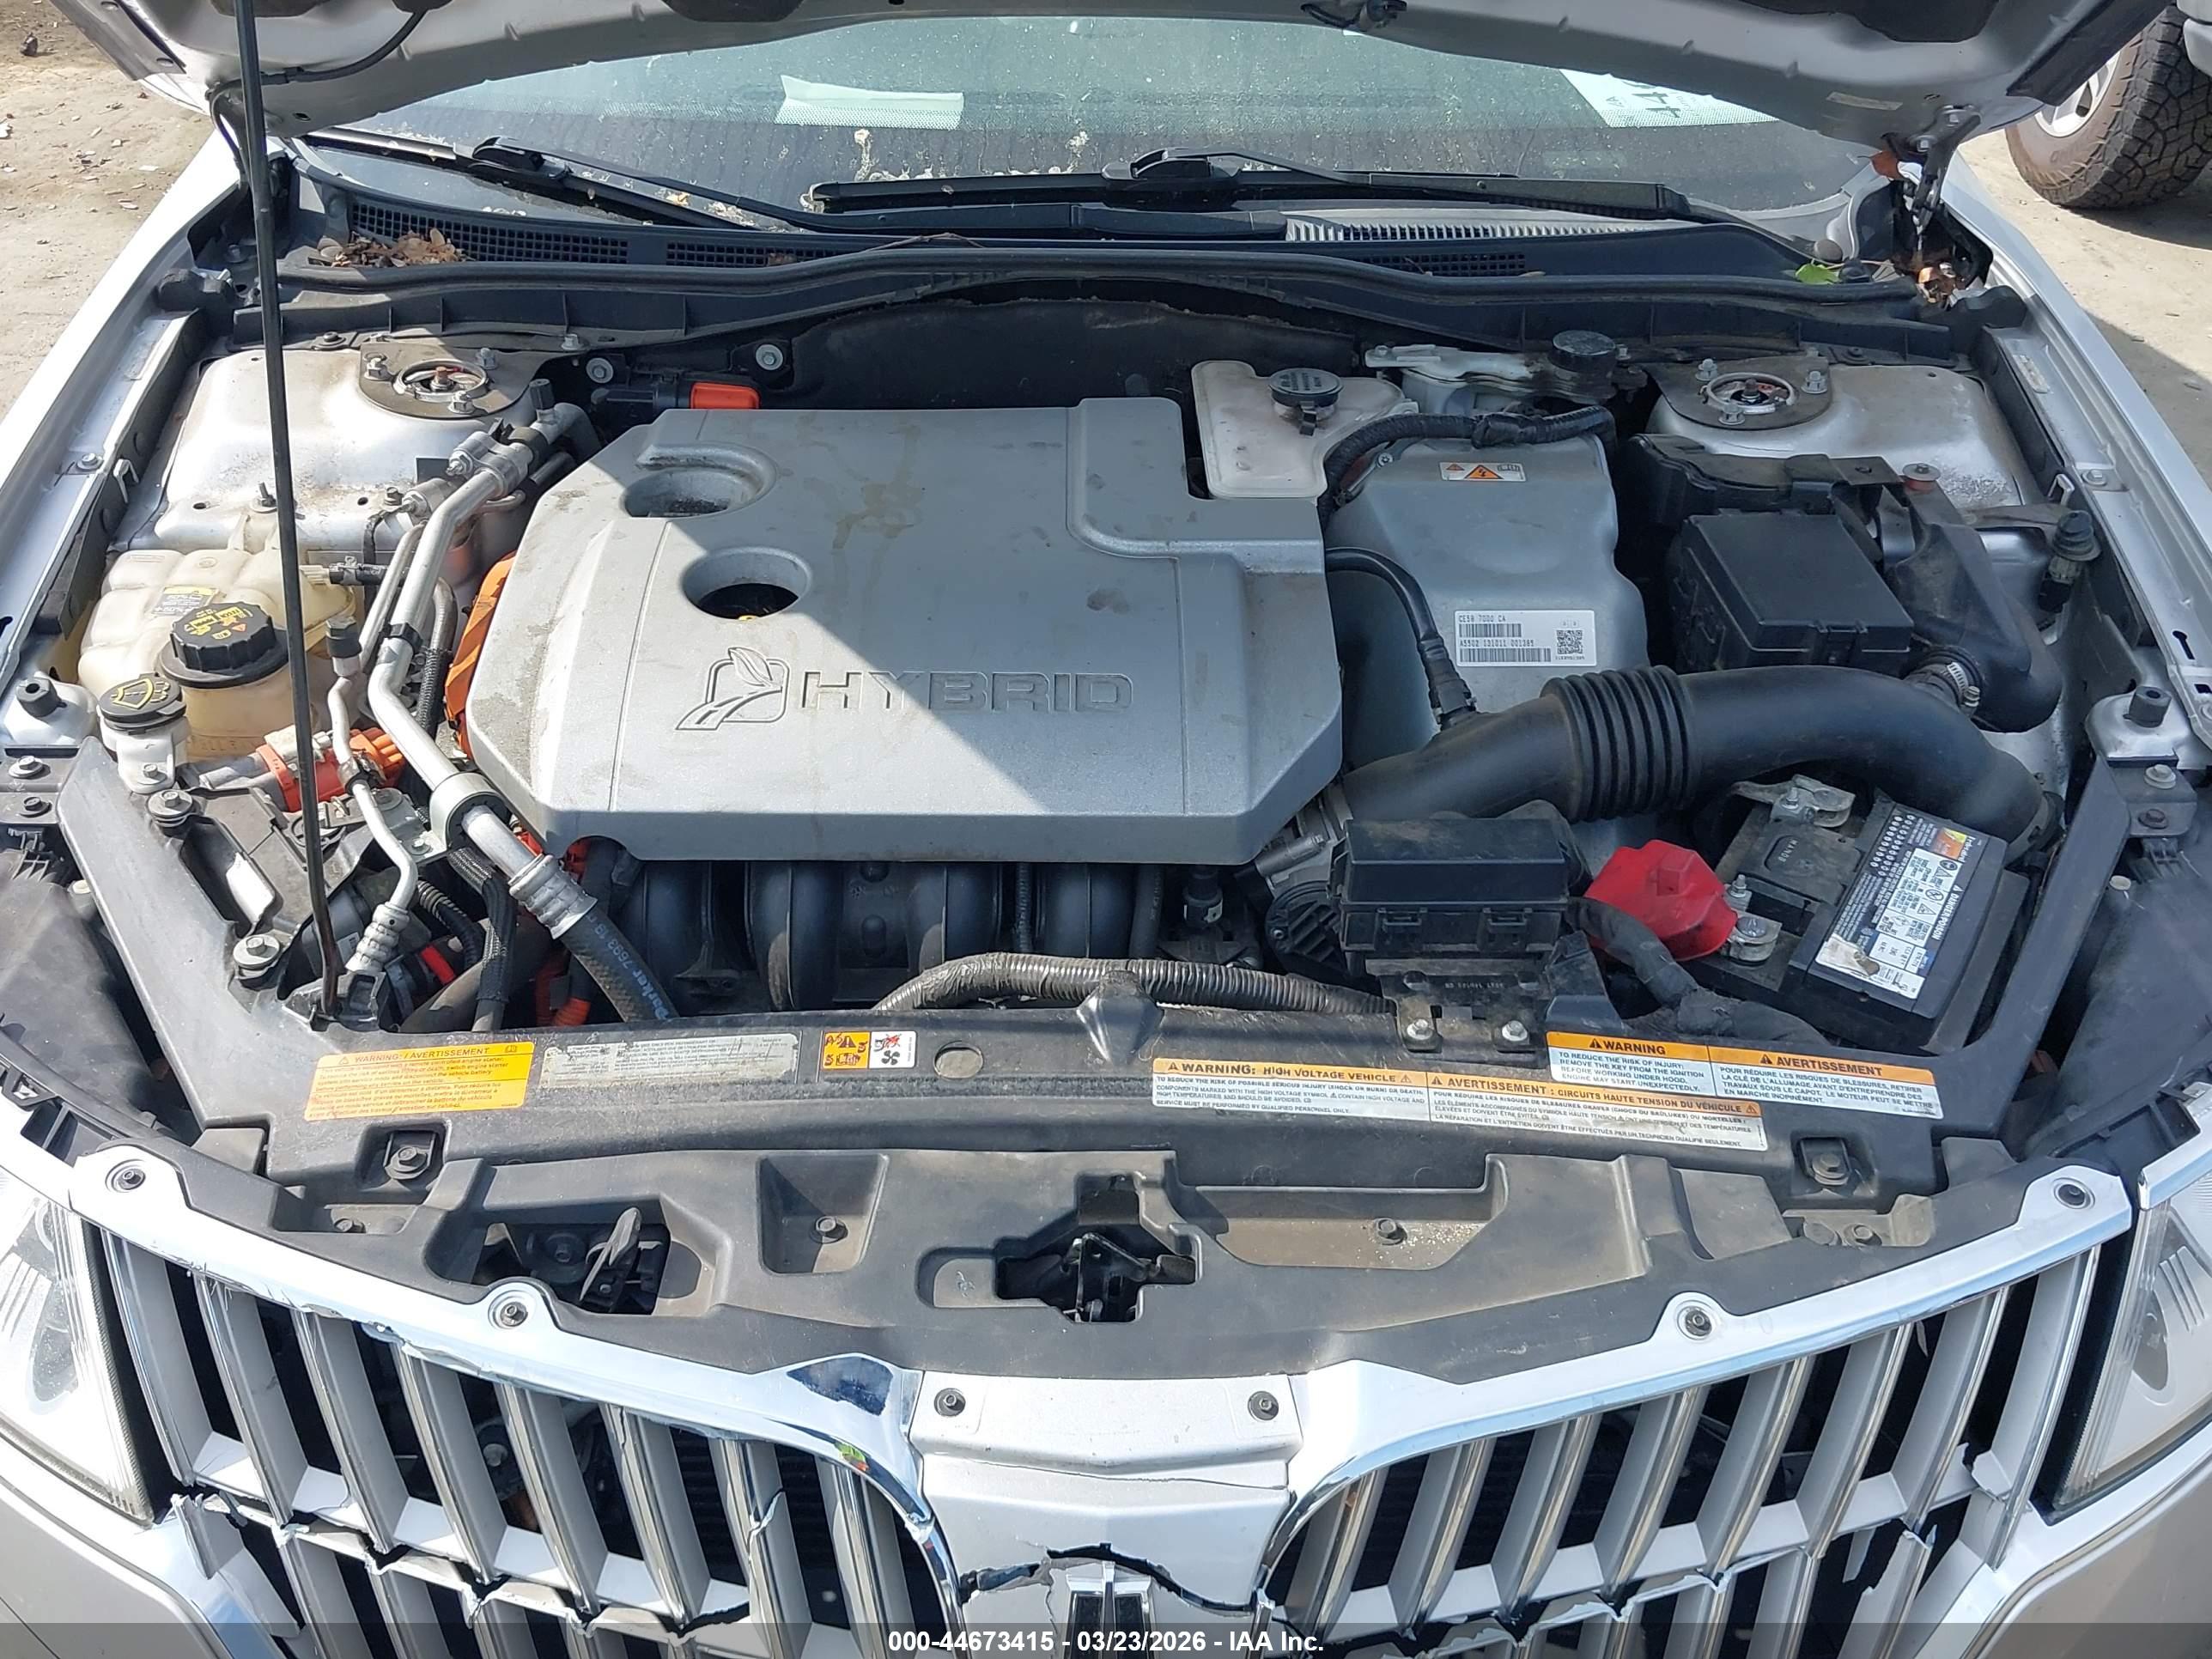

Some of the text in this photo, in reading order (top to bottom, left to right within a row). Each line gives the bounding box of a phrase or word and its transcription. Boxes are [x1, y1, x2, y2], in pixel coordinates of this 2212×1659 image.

[800, 671, 1134, 713] HYBRID
[1930, 915, 1948, 940] POISON
[632, 969, 670, 1020] Parker
[410, 1048, 489, 1059] AVERTISSEMENT
[1602, 1040, 1665, 1054] WARNING
[1181, 1061, 1395, 1082] WARNING: HIGH VOLTAGE VEHICLE
[1559, 1058, 1592, 1066] REMOVE
[1669, 1069, 1705, 1078] IGNITION
[1560, 1065, 1591, 1073] BEFORE
[1594, 1068, 1632, 1078] WORKING
[1633, 1073, 1660, 1081] UNDER
[1775, 1056, 1882, 1076] AVERTISSEMENT
[1448, 1077, 1547, 1095] AVERTISSEMENT
[1557, 1088, 1601, 1100] CIRCUITS
[1603, 1092, 1634, 1103] HAUTE
[1637, 1095, 1677, 1107] TENSION
[1680, 1099, 1692, 1109] DU
